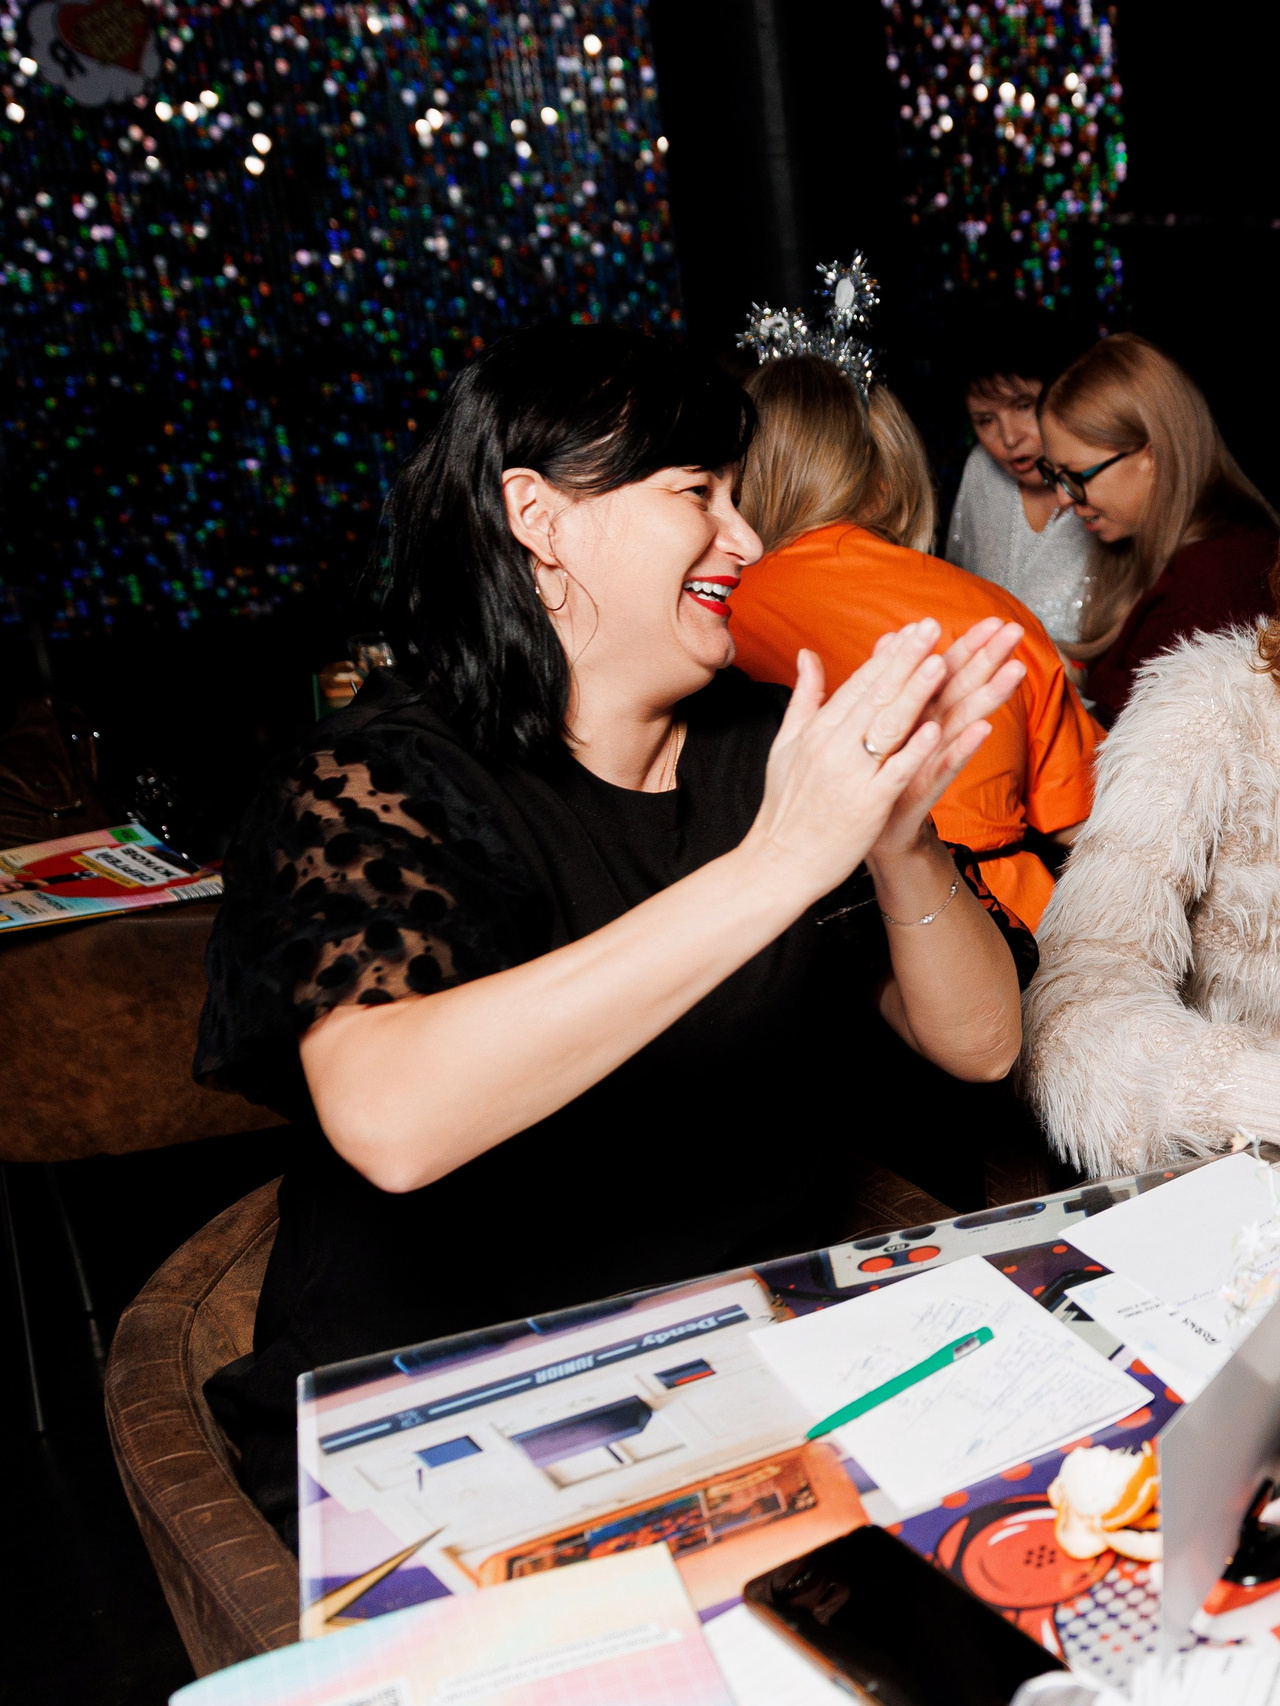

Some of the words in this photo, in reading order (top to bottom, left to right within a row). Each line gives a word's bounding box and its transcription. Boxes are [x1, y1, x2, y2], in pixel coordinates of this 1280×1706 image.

[95, 852, 155, 881] СЕРГЕЙ
[121, 847, 177, 877] ЖУКОВ
[641, 1316, 719, 1347] Dendy
[535, 1355, 596, 1384] JUNIOR
